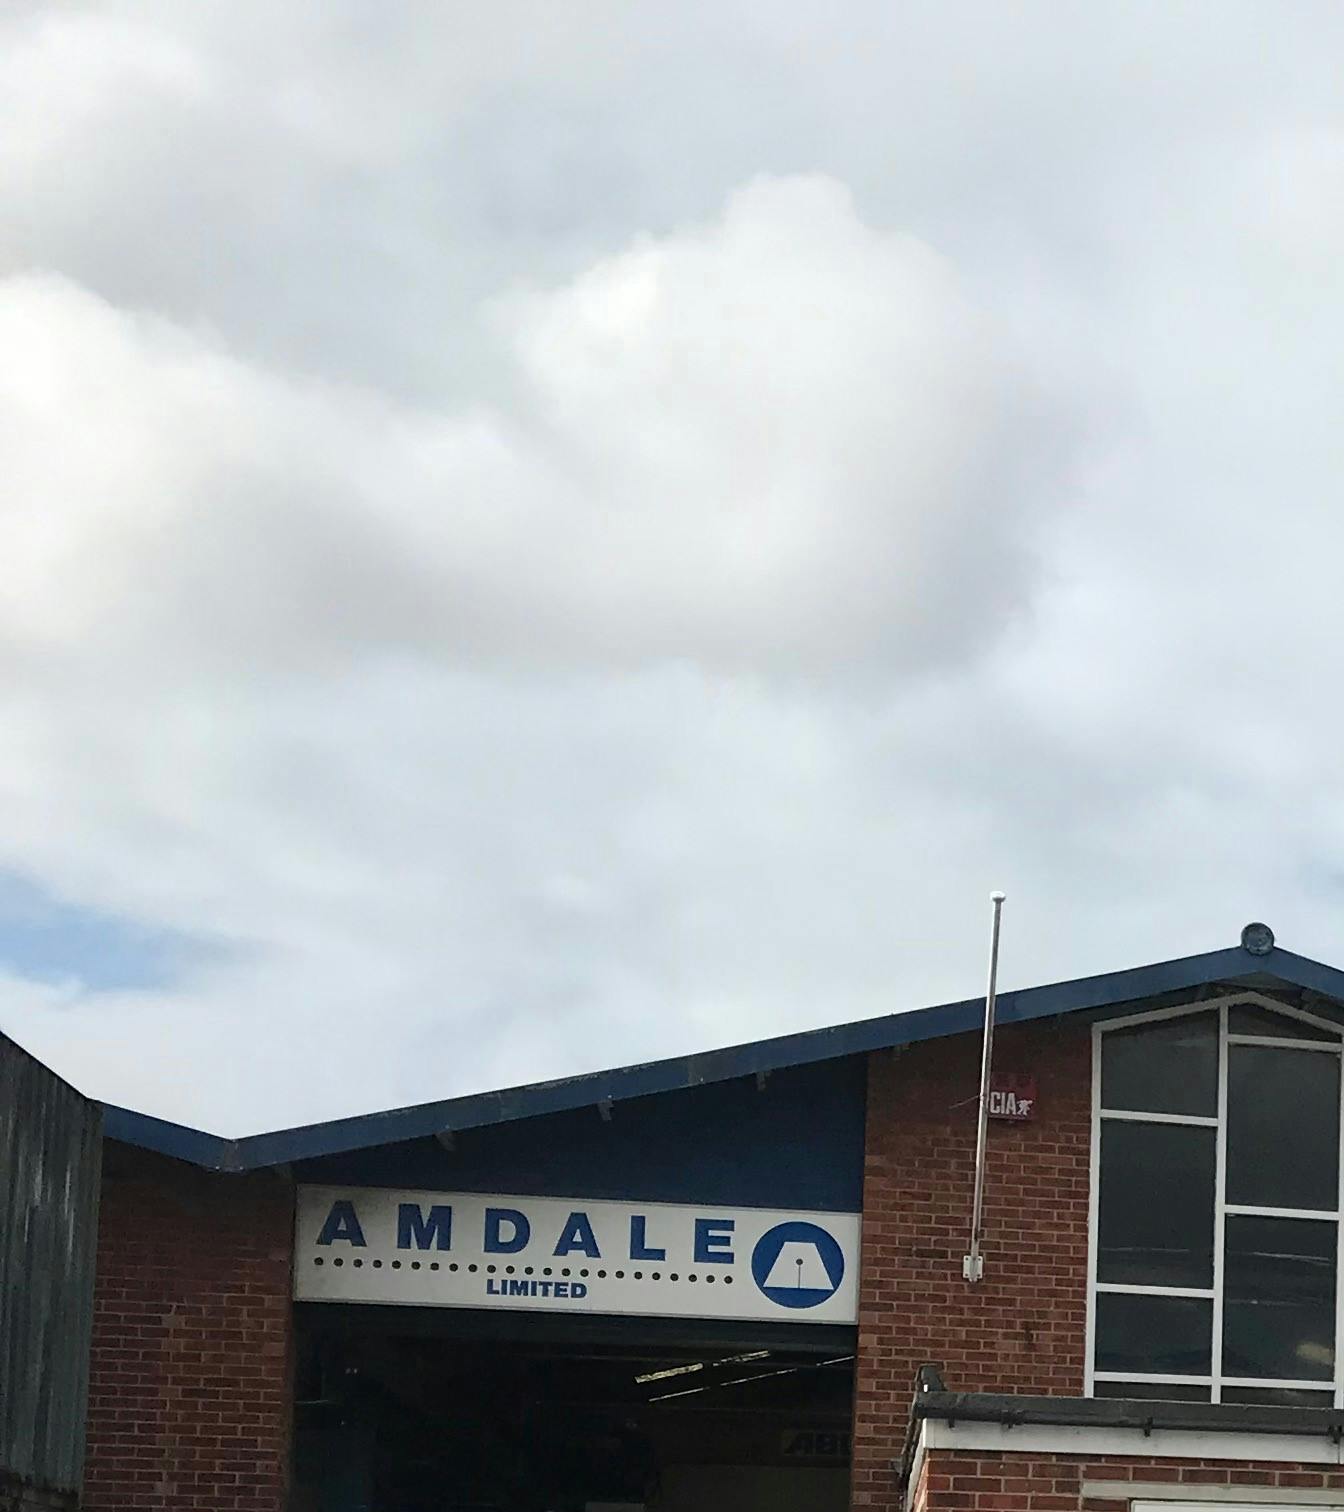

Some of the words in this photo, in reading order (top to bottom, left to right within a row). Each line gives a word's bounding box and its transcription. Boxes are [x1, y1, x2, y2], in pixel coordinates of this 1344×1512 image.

[990, 1091, 1017, 1115] CIA
[315, 1199, 736, 1265] AMDALE
[485, 1278, 588, 1300] LIMITED
